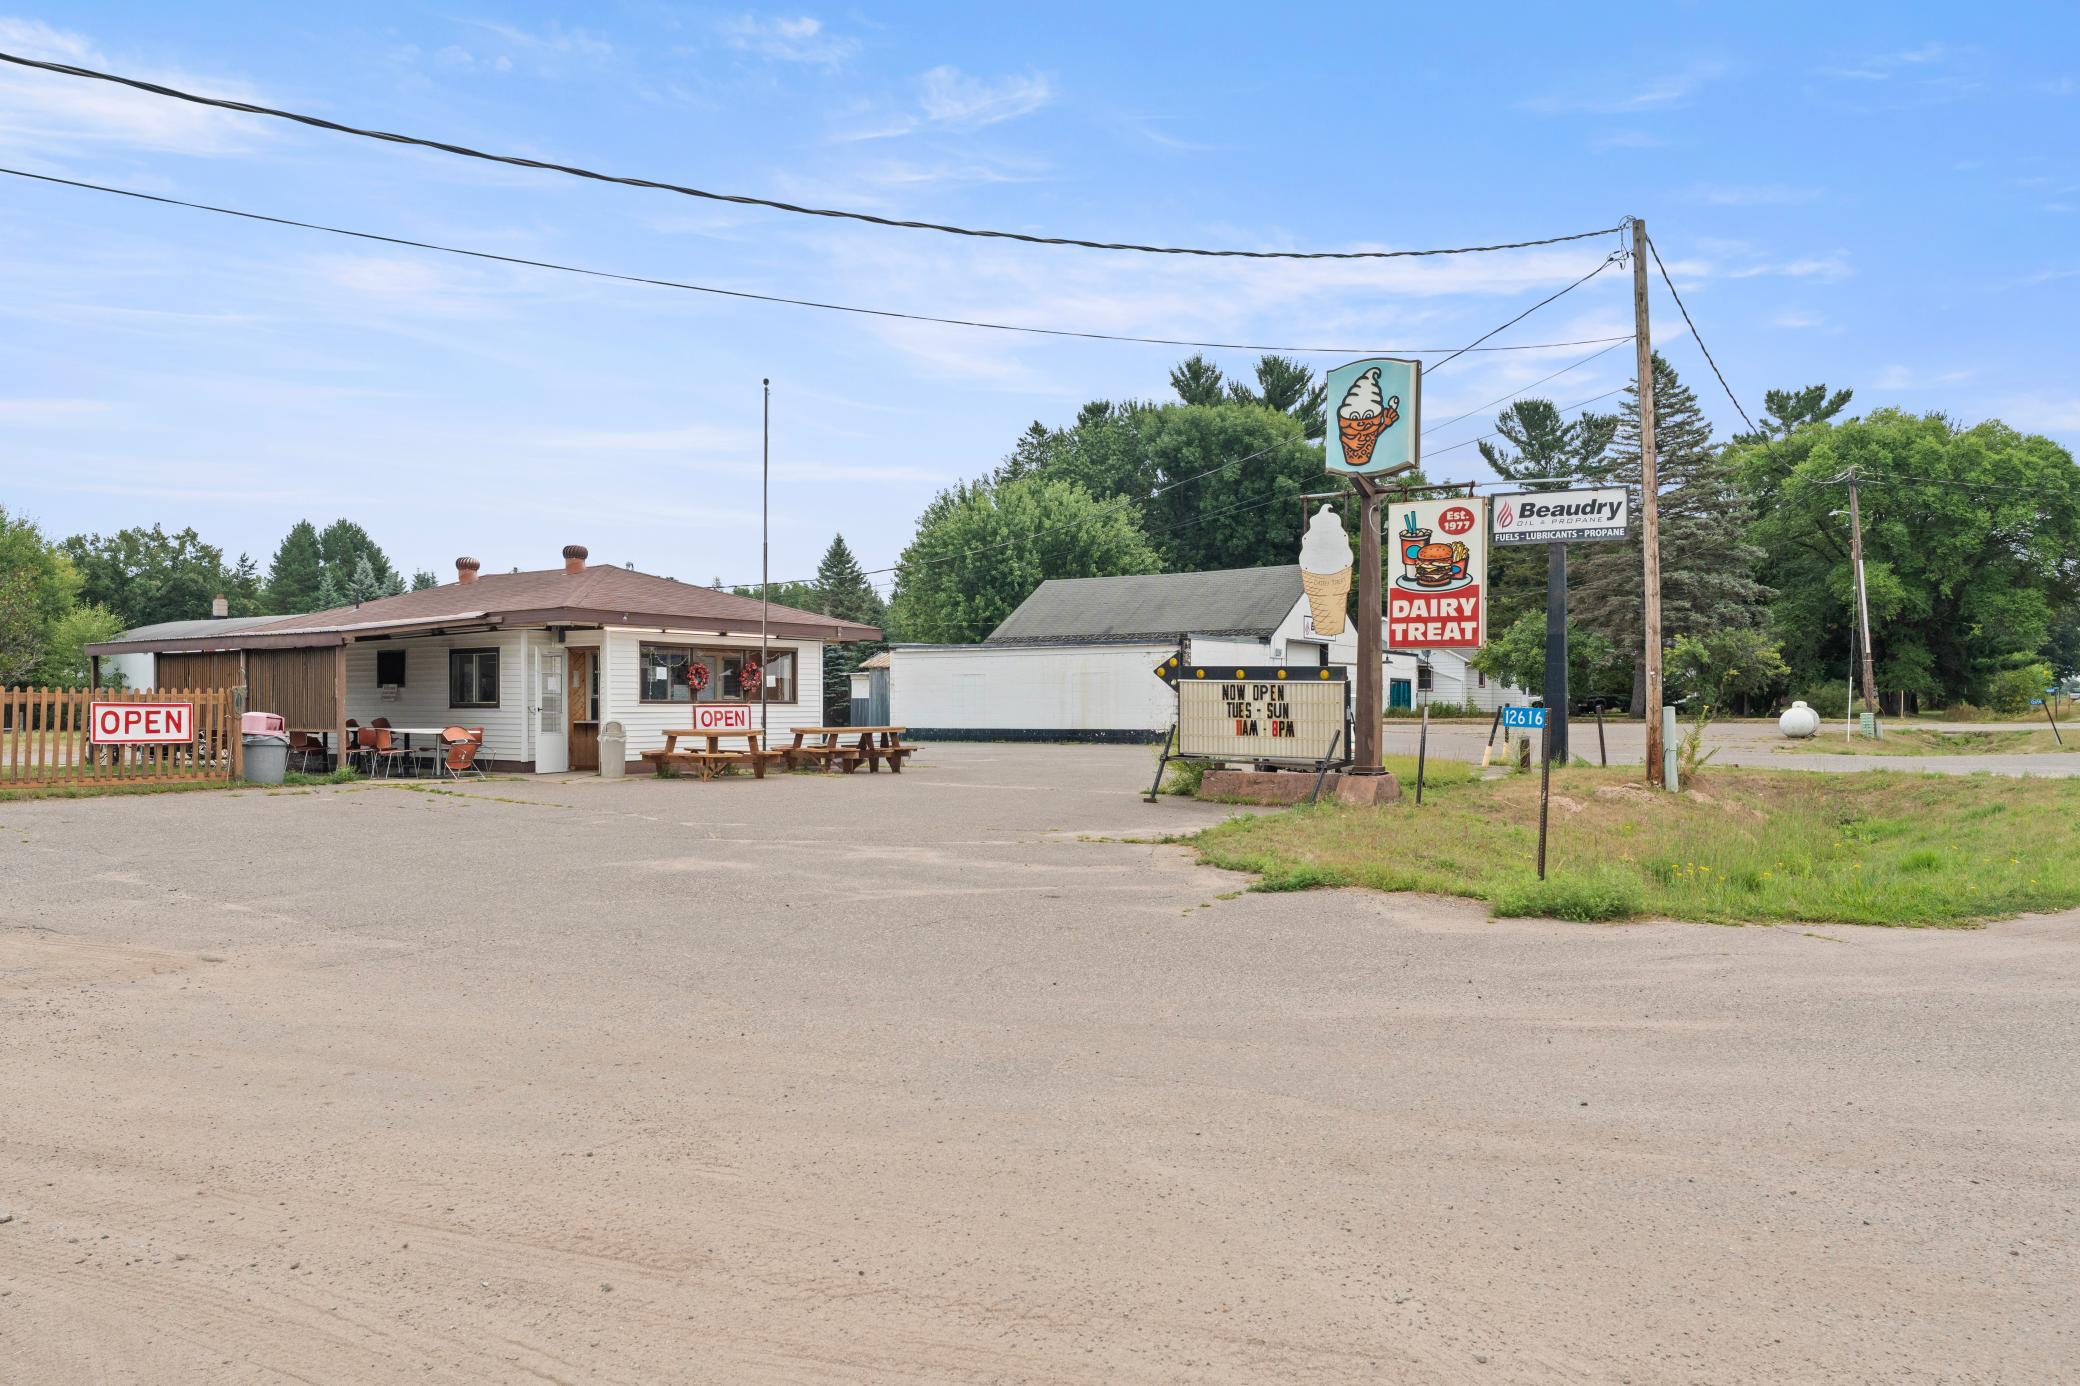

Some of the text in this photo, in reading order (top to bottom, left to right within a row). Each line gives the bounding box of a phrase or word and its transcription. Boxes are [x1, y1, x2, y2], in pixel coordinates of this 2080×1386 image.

[1446, 511, 1469, 520] Est.
[1519, 499, 1623, 520] Beaudry
[1444, 521, 1470, 531] 1977
[1495, 533, 1520, 541] FUELS
[1526, 530, 1578, 540] LUBRICANTS
[1584, 528, 1625, 537] PROPANE
[1392, 598, 1477, 618] DAIRY
[1391, 622, 1477, 641] TREAT
[1222, 684, 1284, 702] NOW OPEN
[701, 710, 744, 727] OPEN
[1227, 702, 1251, 718] TUES
[1267, 702, 1289, 719] SUN
[1505, 710, 1543, 725] 12616
[100, 710, 182, 734] OPEN
[1236, 720, 1258, 736] 11AM
[1272, 720, 1295, 737] 8PM
